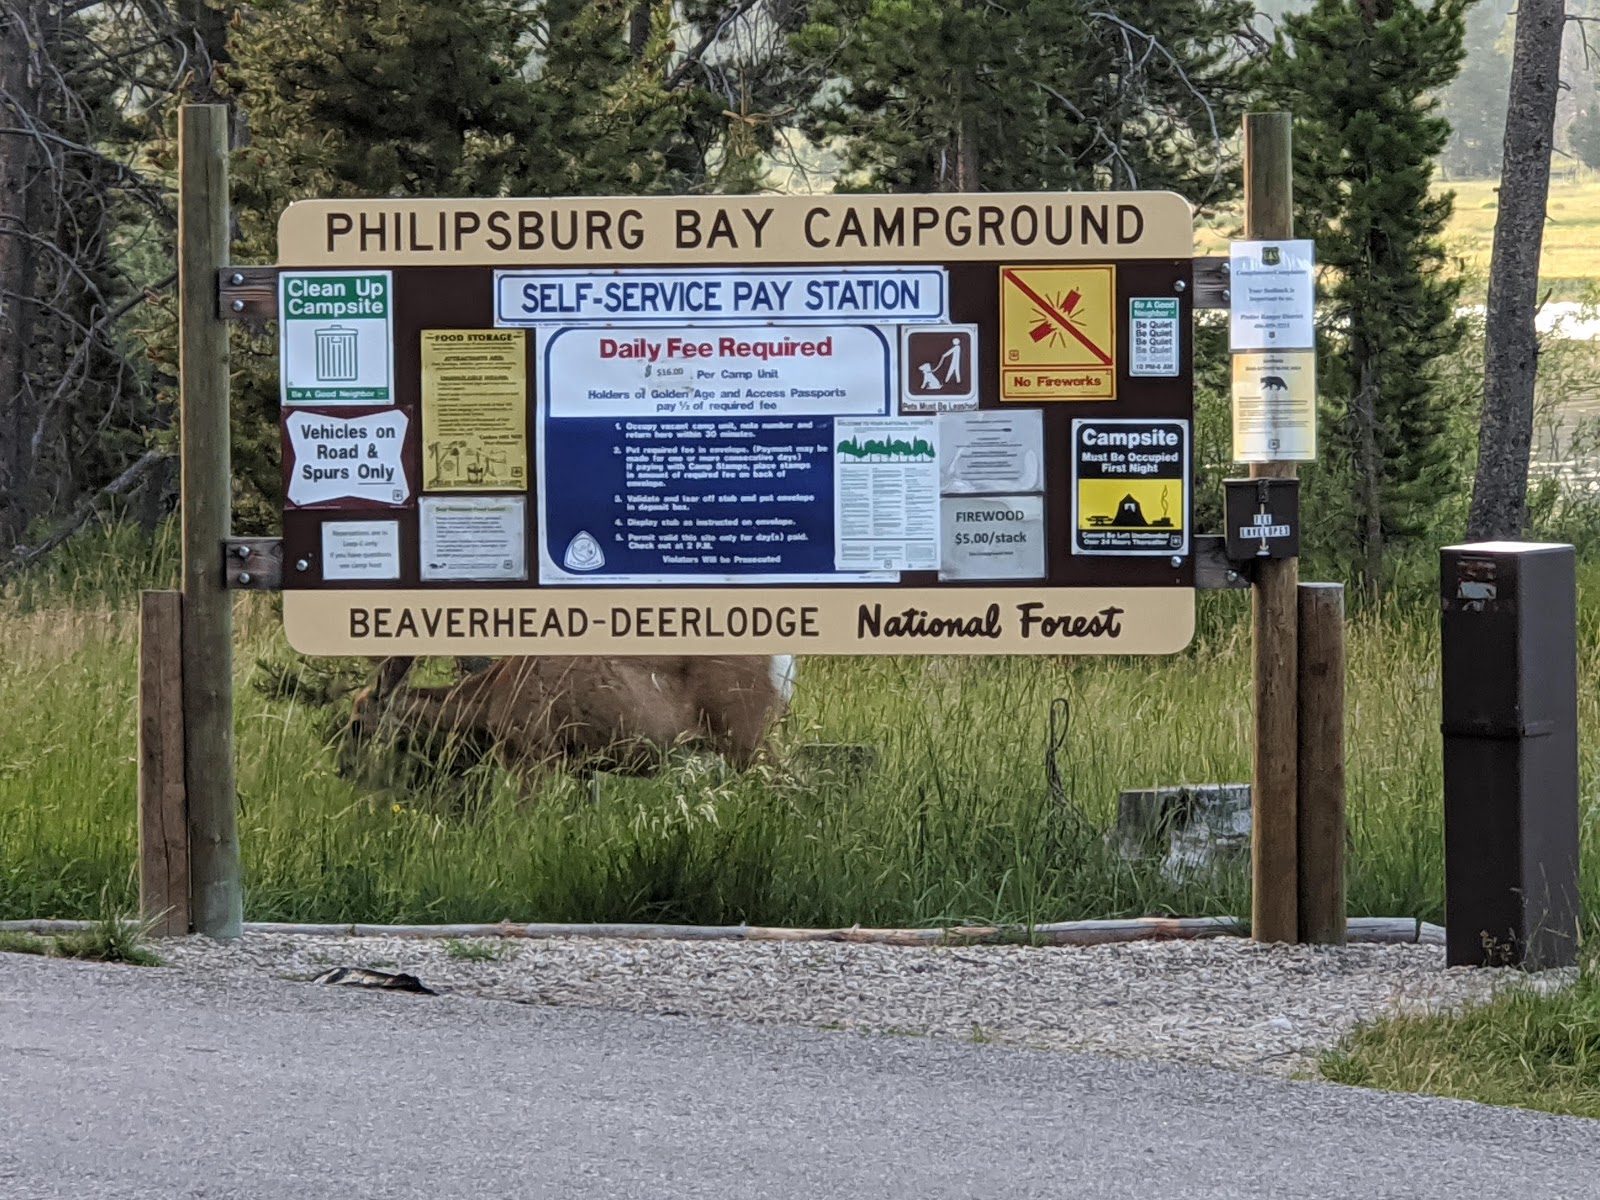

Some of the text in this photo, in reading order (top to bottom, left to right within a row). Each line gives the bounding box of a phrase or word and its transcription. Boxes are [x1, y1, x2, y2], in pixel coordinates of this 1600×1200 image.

[327, 205, 1145, 252] PHILIPSBURG BAY CAMPGROUND
[288, 279, 383, 300] Clean Up
[521, 279, 920, 313] SELF-SERVICE PAY STATION
[288, 298, 384, 317] Campsite
[1134, 309, 1169, 317] Neighbor
[1149, 321, 1172, 329] Quiet
[467, 333, 512, 341] STORAGE
[1149, 330, 1172, 338] Quiet
[1149, 338, 1172, 346] Quiet
[600, 336, 833, 362] Daily Fee Required
[1149, 346, 1172, 354] Quiet
[657, 368, 684, 376] $16.00
[697, 369, 716, 379] Per
[721, 369, 753, 380] Camp
[757, 369, 779, 379] Unit
[1014, 375, 1102, 388] No Fireworks
[291, 389, 375, 399] Be A Good Neighbor
[588, 387, 847, 400] Holders of Golden Age and Access Passports
[656, 400, 777, 412] pay of required fee
[903, 401, 977, 411] Pets Must Be Leashed
[301, 424, 395, 439] Vehicles on
[1082, 428, 1179, 449] Campsite
[317, 444, 379, 459] Road &
[1082, 452, 1179, 463] Must Be Occupied
[302, 464, 394, 482] Spurs Only
[1101, 463, 1159, 474] First Night
[956, 510, 1025, 523] FIREWOOD
[955, 531, 1026, 545] $5.00/stack
[350, 601, 1124, 639] BEAVERHEAD-DEERLODGE National Forest
